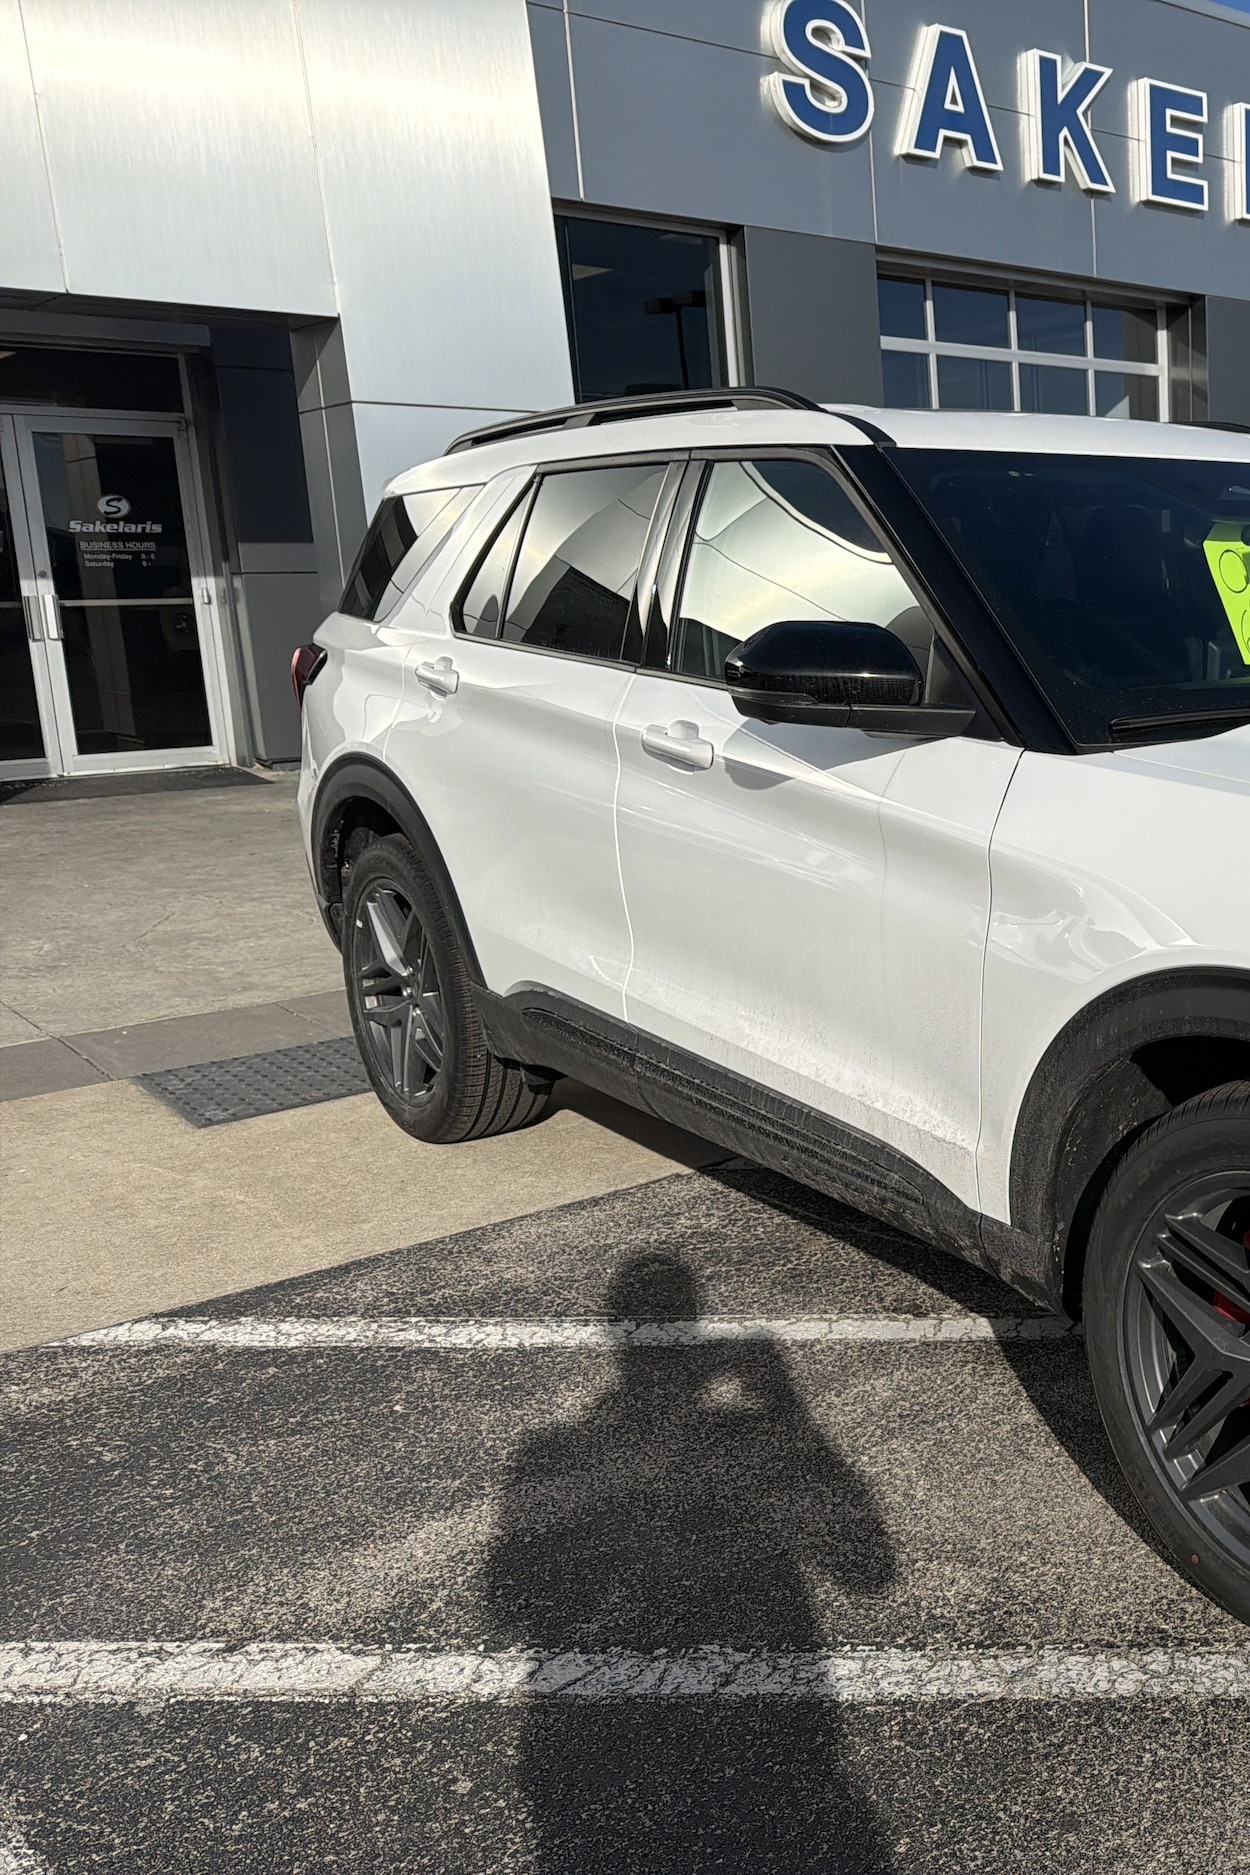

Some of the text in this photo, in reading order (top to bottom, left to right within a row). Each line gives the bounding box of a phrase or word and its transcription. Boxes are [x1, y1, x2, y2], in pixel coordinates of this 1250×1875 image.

[68, 520, 163, 533] Sakelaris
[80, 541, 156, 549] BUSINESS HOURS
